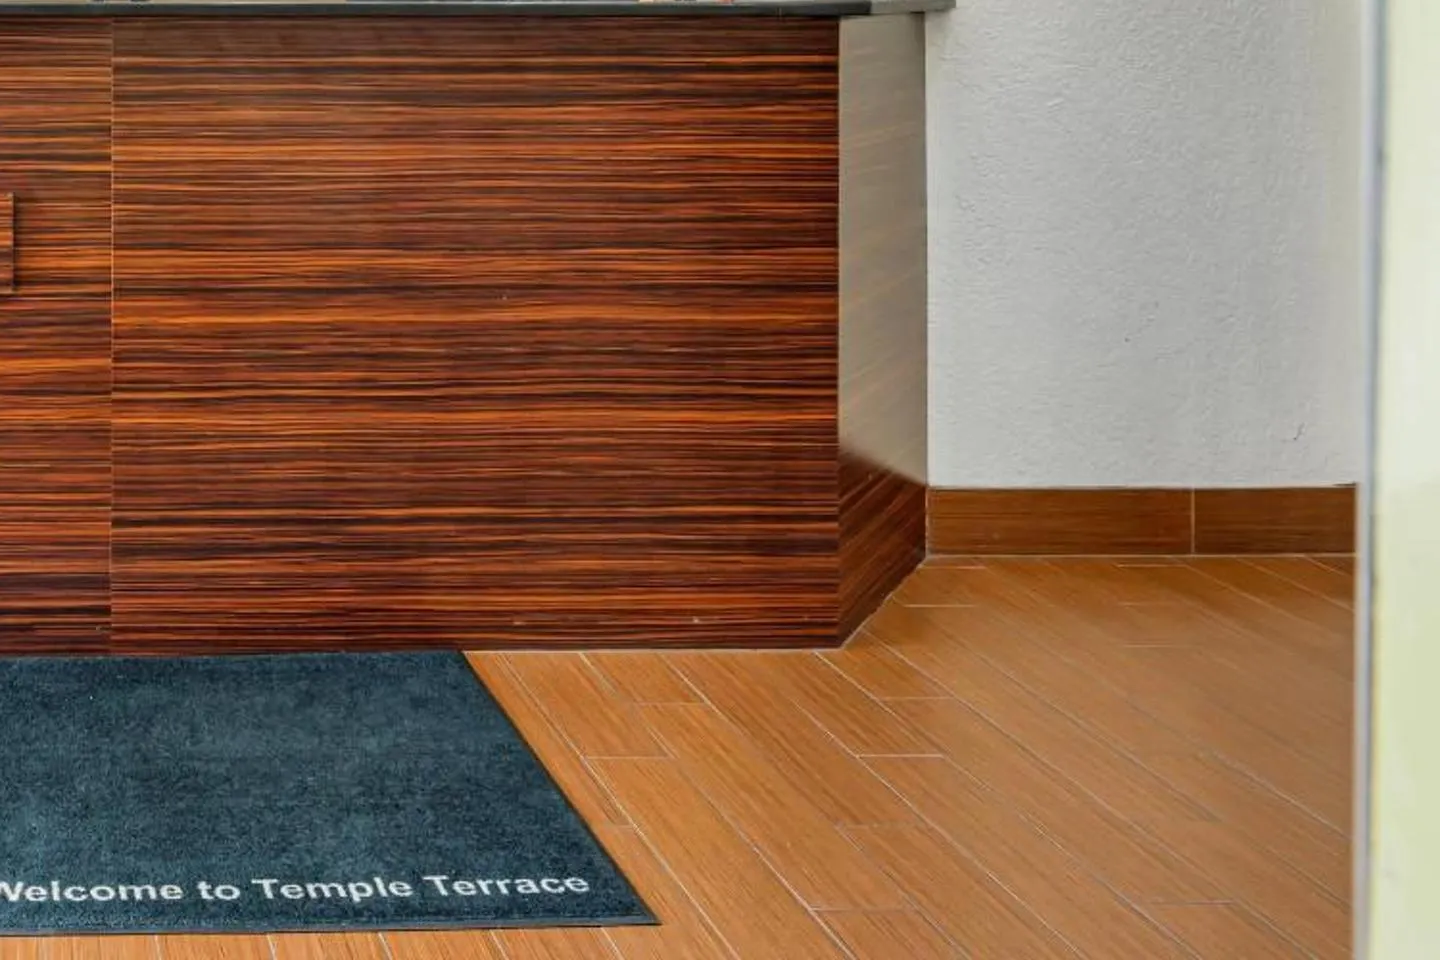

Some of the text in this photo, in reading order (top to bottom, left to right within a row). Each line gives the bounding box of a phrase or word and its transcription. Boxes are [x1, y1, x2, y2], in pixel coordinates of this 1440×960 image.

[197, 880, 242, 902] to
[252, 876, 414, 904] Temple
[423, 872, 591, 898] Terrace
